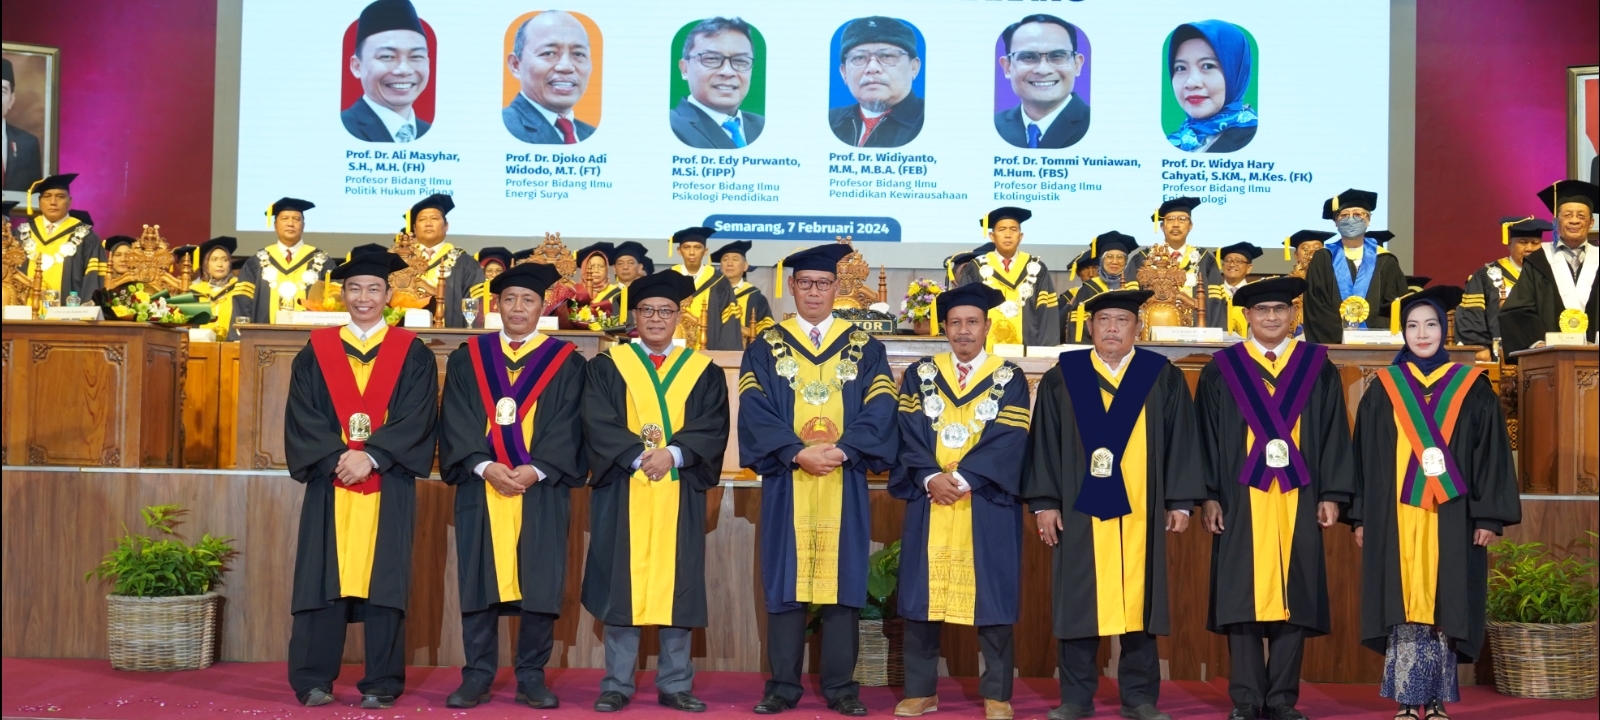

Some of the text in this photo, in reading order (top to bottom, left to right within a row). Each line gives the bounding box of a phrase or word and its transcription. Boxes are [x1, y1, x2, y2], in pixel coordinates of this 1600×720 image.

[346, 150, 459, 162] Prof. Dr. Ali Masyhar,
[506, 153, 606, 164] Prof. Dr. Djoko Adi
[673, 155, 800, 167] Prof. Dr. Edy Purwanto,
[829, 152, 937, 164] Prof. Dr. Widiyanto,
[349, 162, 425, 173] S.H., M.H. (FH)
[994, 156, 1141, 168] Prof. Dr. Tommi Yuniawan,
[1162, 159, 1274, 170] Prof. Dr. Widya Hary
[506, 165, 600, 177] Widodo, M.T. (FT)
[672, 166, 735, 178] M.Si. (FIPP)
[829, 164, 927, 176] M.M., M.B.A. (FEB)
[994, 168, 1068, 179] M.Hum. (FBS)
[346, 176, 451, 186] Profesor Bidang Ilmu
[1162, 170, 1312, 183] Cahyati, S.KM., M.Kes. (FK)
[506, 178, 612, 189] Profesor Bidang Ilmu
[673, 181, 779, 193] Profesor Bidang Ilmu
[830, 178, 936, 189] Profesor Bidang Ilmu
[994, 181, 1102, 192] Profesor Bidang Ilmu
[1163, 183, 1206, 192] Profesor
[1208, 184, 1245, 195] Bidang
[345, 186, 377, 194] Politik
[381, 187, 415, 195] Hukum
[506, 189, 568, 200] Energi Surya
[830, 189, 967, 199] Pendidikan Kewirausahaan
[672, 192, 778, 203] Psikologi Pendidikan
[994, 192, 1060, 202] Ekolinguistik
[715, 221, 889, 235] Semarang, 7 Februari 2024
[853, 321, 883, 331] TOR
